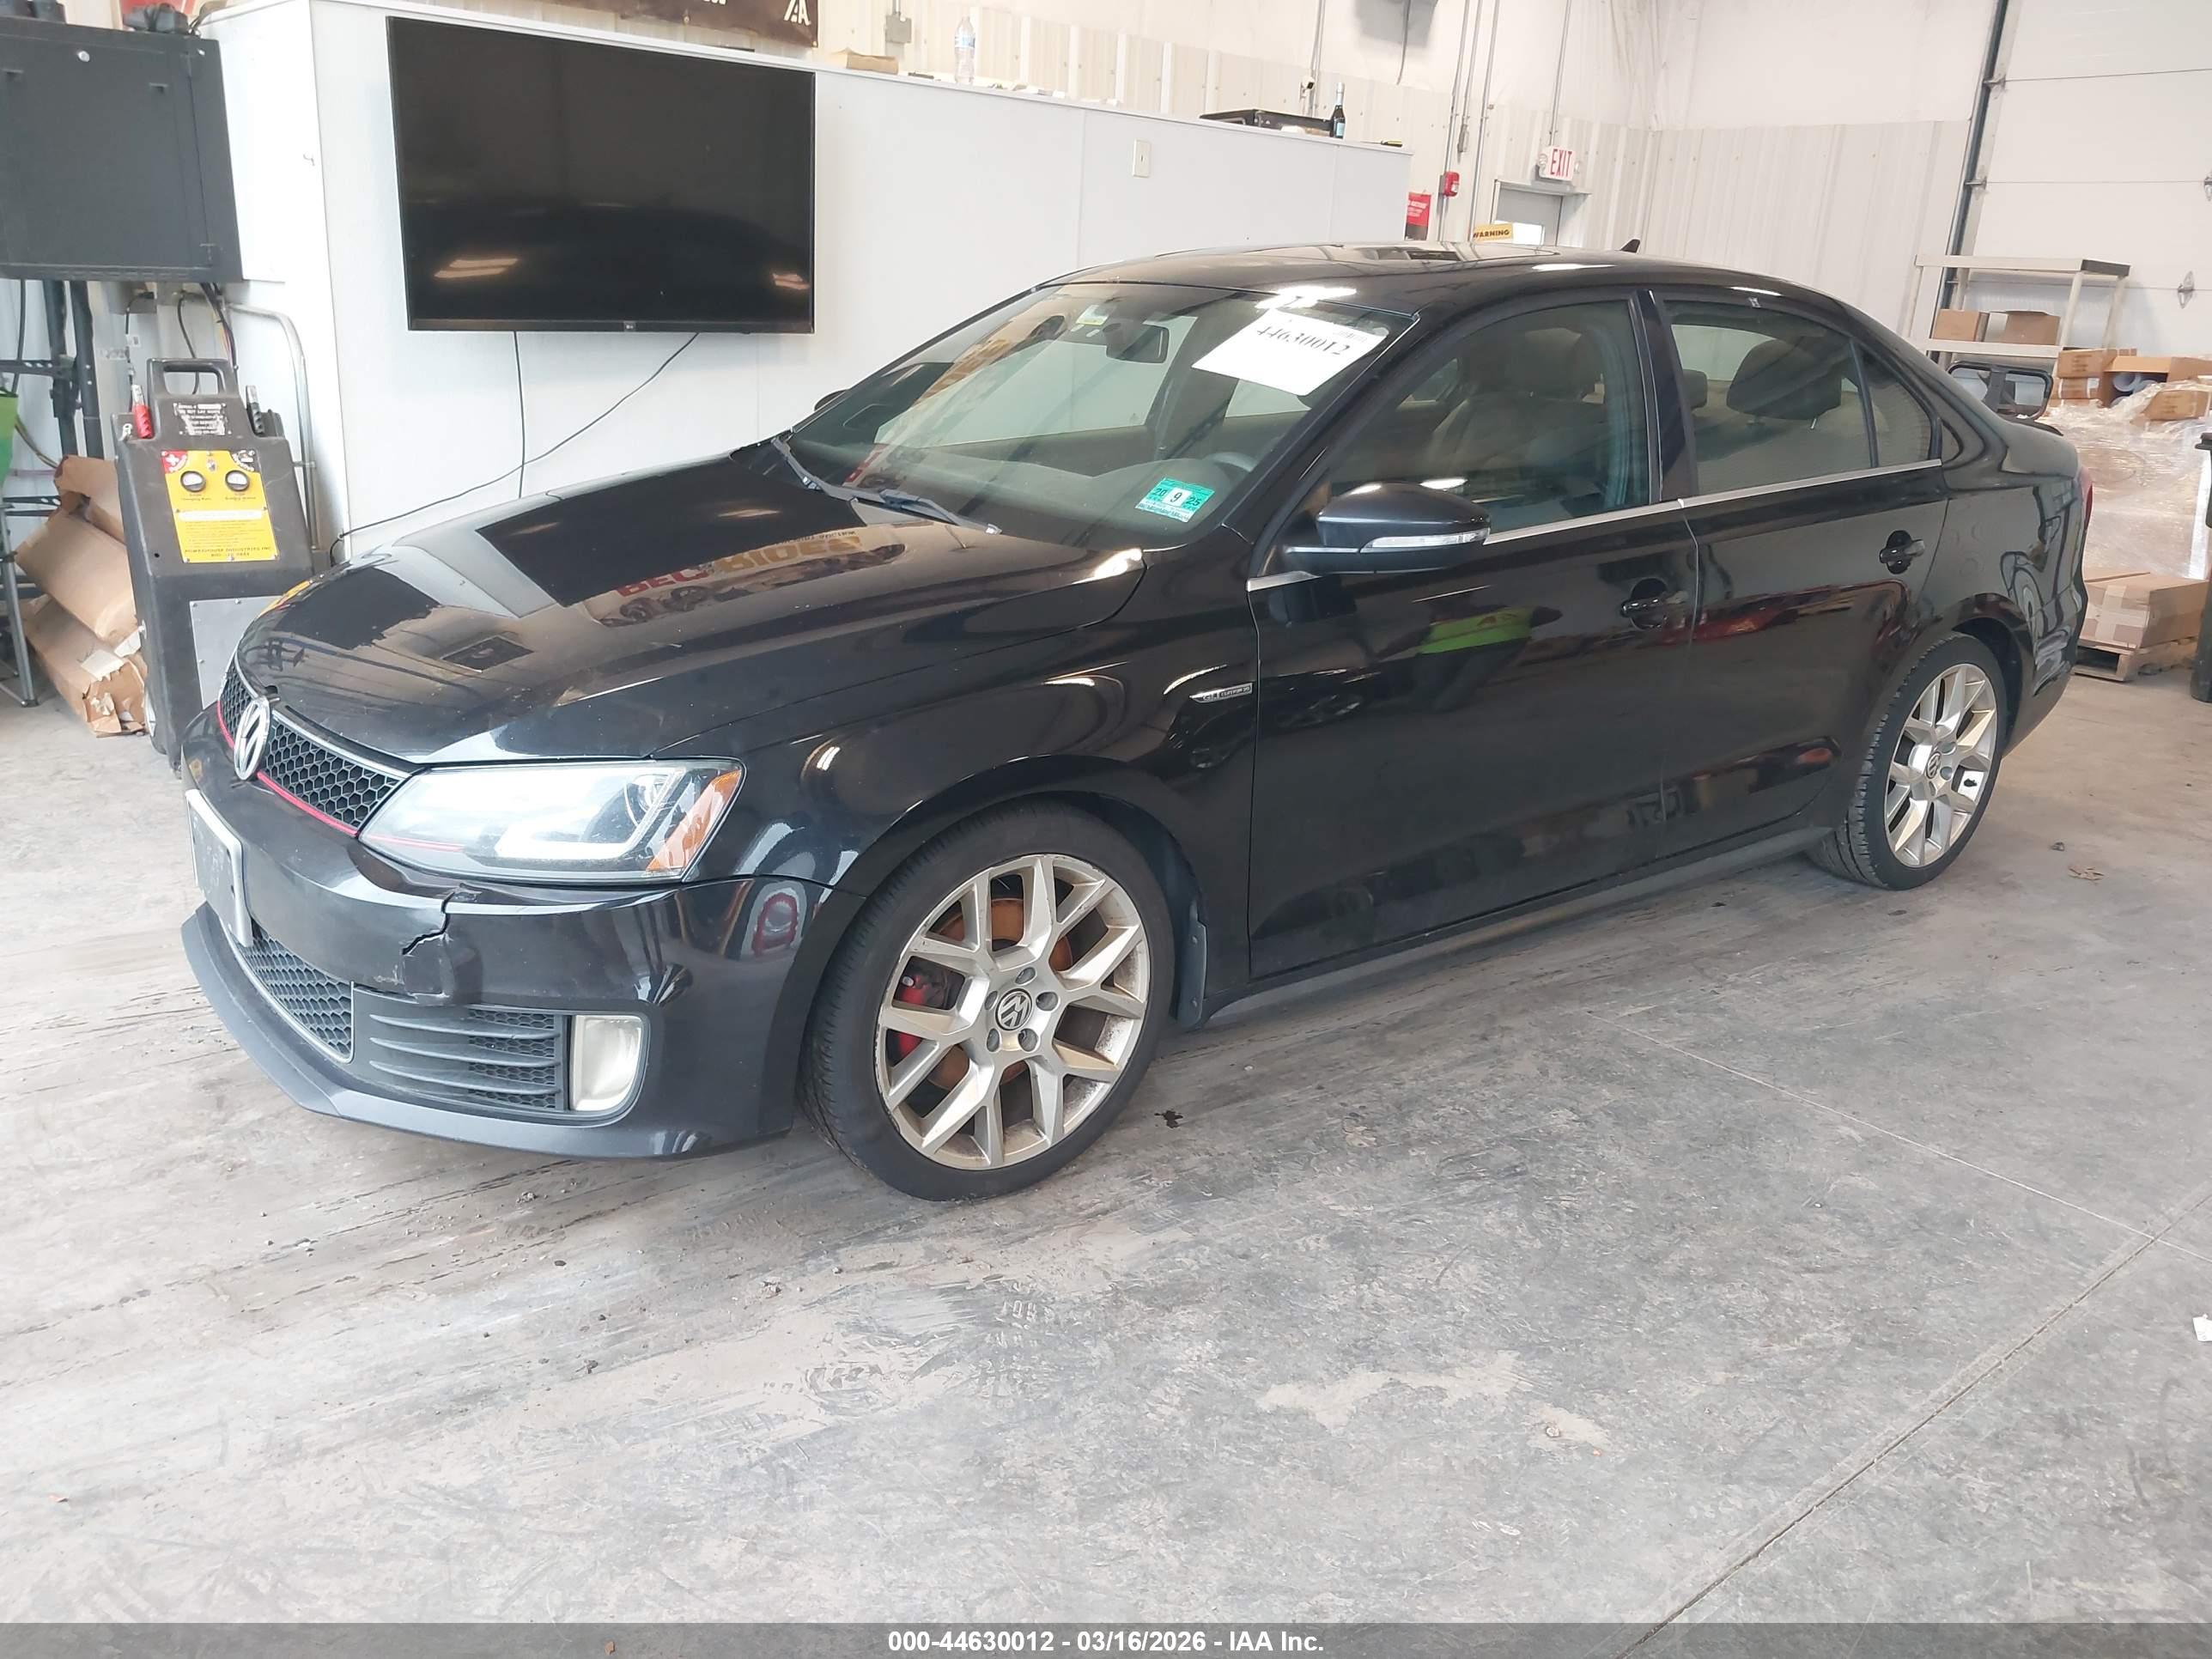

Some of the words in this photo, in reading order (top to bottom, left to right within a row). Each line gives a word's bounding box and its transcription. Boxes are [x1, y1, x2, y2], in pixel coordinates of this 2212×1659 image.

[1550, 149, 1573, 177] EXIT
[1257, 325, 1351, 356] 44630012
[1152, 488, 1168, 498] 20
[1170, 492, 1182, 503] 9
[1186, 496, 1201, 507] 25
